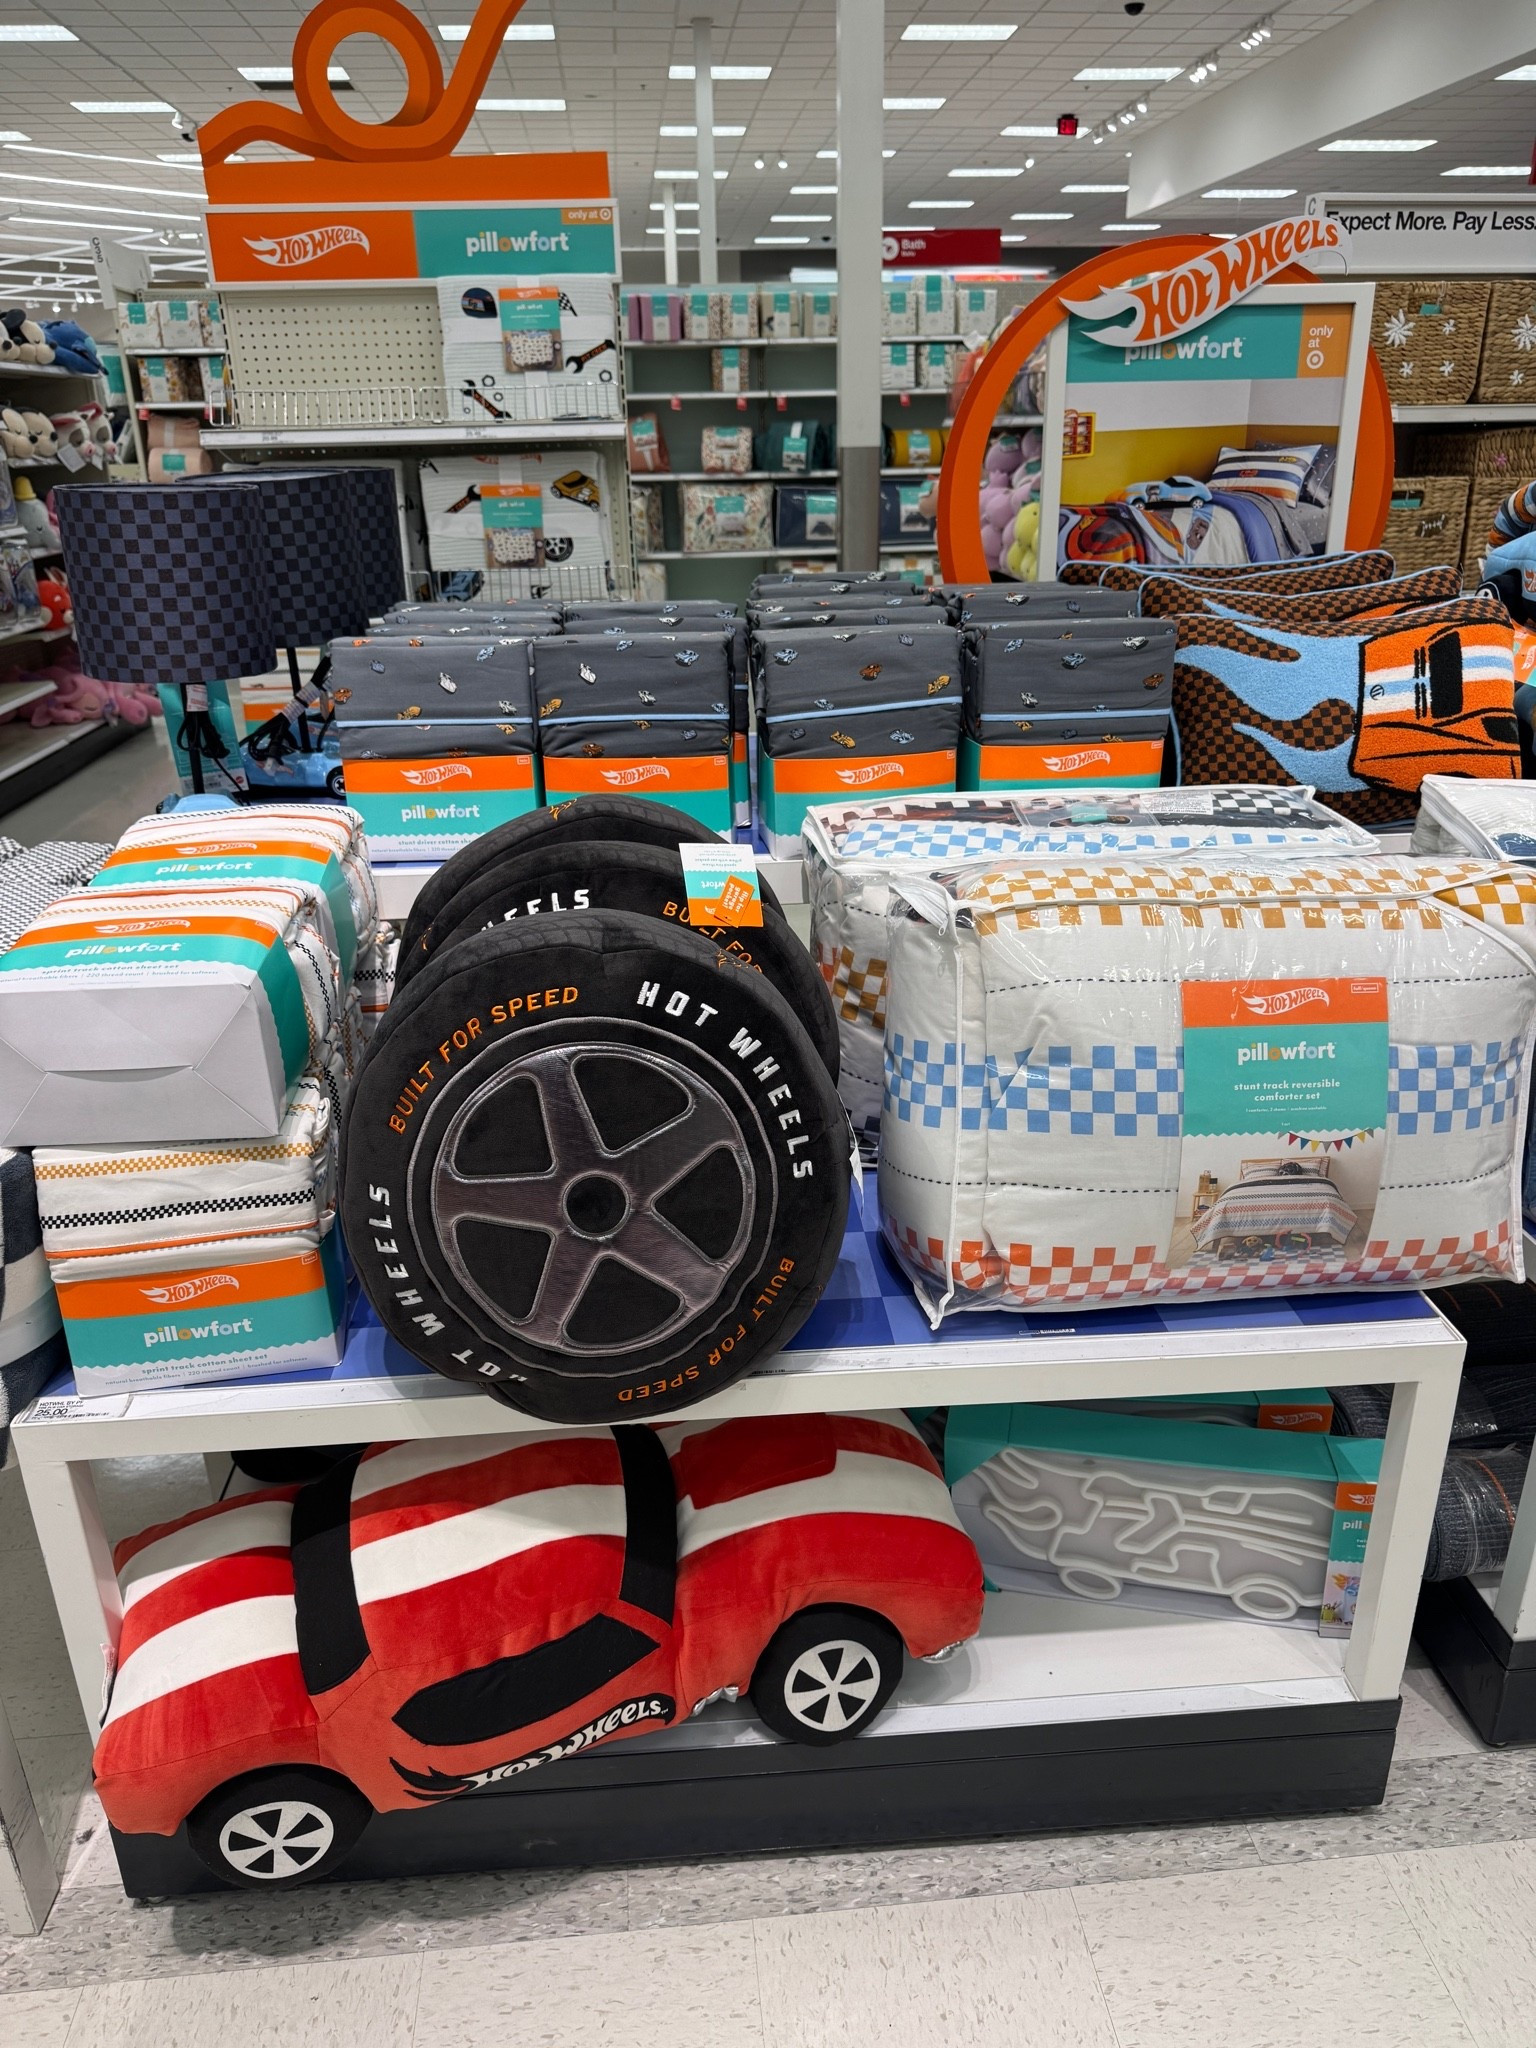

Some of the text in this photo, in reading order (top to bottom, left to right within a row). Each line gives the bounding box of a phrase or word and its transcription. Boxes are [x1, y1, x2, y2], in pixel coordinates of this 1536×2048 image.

[568, 210, 598, 221] only at
[1396, 211, 1447, 231] More.
[1453, 211, 1488, 235] Pay
[92, 237, 104, 263] C35
[273, 237, 309, 264] HOT
[466, 231, 570, 257] pillowfort
[901, 239, 926, 250] Bath
[1128, 268, 1212, 343] HOT
[1309, 325, 1334, 339] only
[1308, 337, 1320, 348] at
[402, 804, 480, 822] pillowfort
[155, 861, 253, 875] pillowfort
[65, 942, 182, 959] pillowfort
[1263, 996, 1288, 1014] HOT
[388, 986, 579, 1135] BUILT FOR SPEED
[1238, 1041, 1336, 1066] pillowfort
[636, 980, 814, 1179] HOT WHEELS
[1234, 1078, 1341, 1091] stunt track reversible
[1254, 1092, 1321, 1102] comforter set
[368, 1183, 446, 1337] WHEELS
[166, 1284, 193, 1302] HOT
[144, 1318, 253, 1347] pillowfort
[617, 1257, 795, 1402] BUILT FOR SPEED
[142, 1366, 168, 1375] sprint
[171, 1362, 195, 1371] track
[197, 1359, 226, 1368] cotton
[228, 1356, 252, 1364] sheet
[34, 1408, 68, 1417] 25.00
[1363, 1495, 1375, 1505] HO
[1342, 1520, 1370, 1531] pillo
[461, 1756, 554, 1793] HOT
